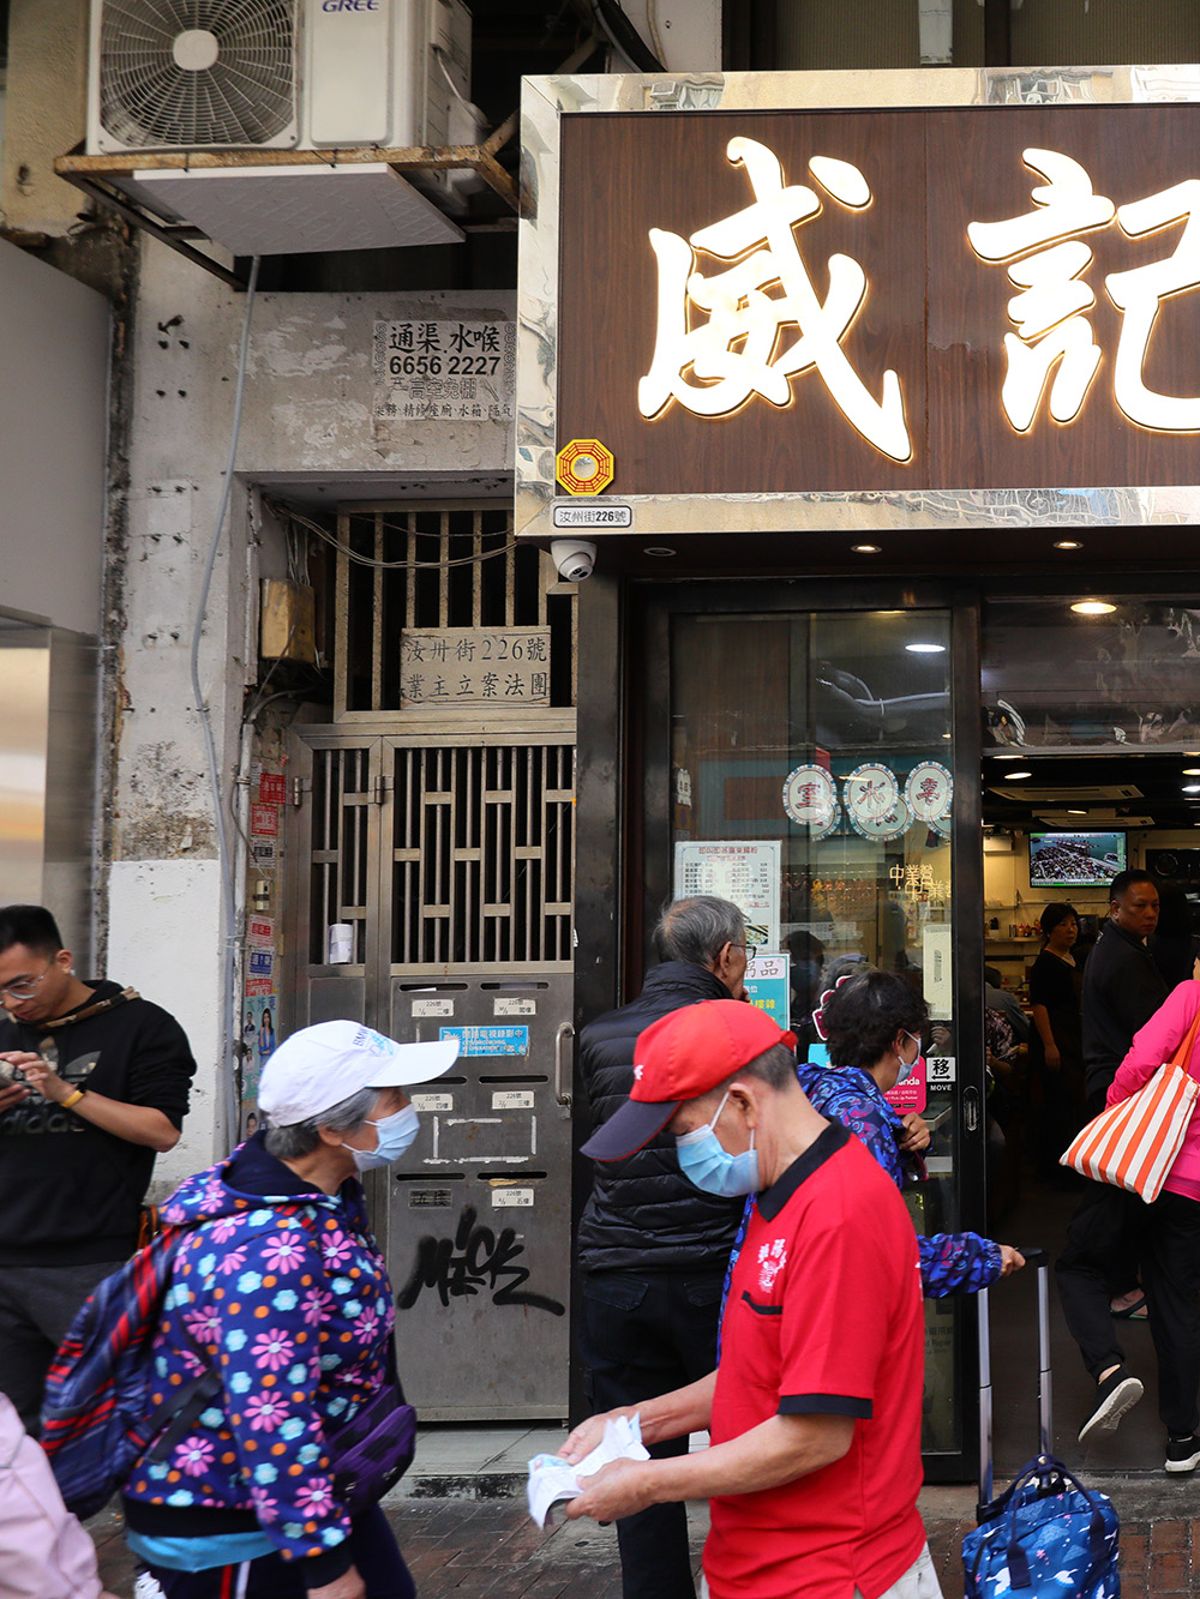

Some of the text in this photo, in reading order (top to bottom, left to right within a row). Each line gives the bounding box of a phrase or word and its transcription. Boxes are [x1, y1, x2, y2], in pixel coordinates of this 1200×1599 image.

[322, 0, 379, 12] GREE
[389, 356, 500, 375] 6656 2227
[560, 510, 626, 522] 汝州街226號
[407, 672, 548, 698] 業主立案法團
[932, 1058, 950, 1074] 移
